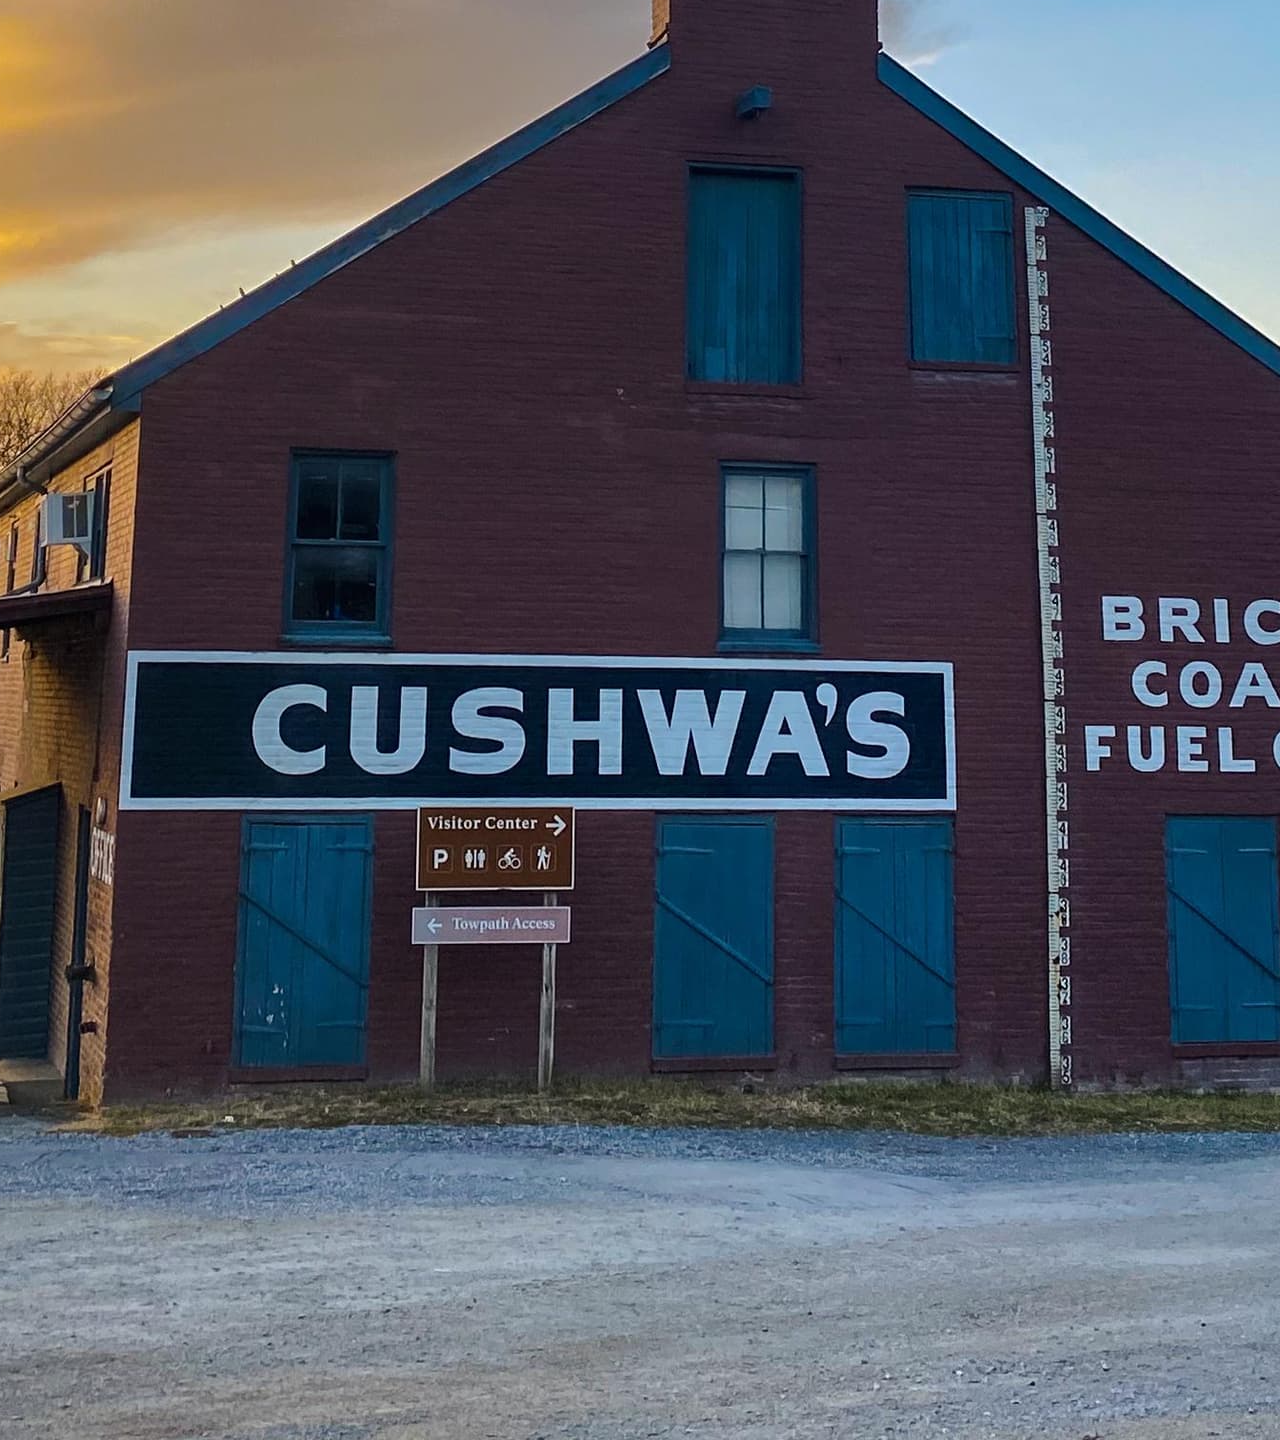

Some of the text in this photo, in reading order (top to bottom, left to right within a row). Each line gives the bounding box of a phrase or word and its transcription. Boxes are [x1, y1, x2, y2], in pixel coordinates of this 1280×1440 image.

[1040, 305, 1048, 330] 55
[1042, 340, 1050, 365] 54
[1043, 376, 1051, 401] 53
[1044, 412, 1052, 437] 52
[1046, 447, 1054, 472] 51
[1047, 484, 1055, 509] 50
[1051, 594, 1060, 620] 47
[1054, 669, 1063, 695] 45
[251, 682, 911, 780] CUSHWA'S
[1055, 708, 1064, 733] 44
[1056, 745, 1065, 771] 43
[1084, 725, 1256, 773] FUEL
[1057, 783, 1066, 810] 42
[427, 816, 538, 830] Visitor Center
[1058, 822, 1066, 849] 41
[433, 849, 448, 870] P
[452, 917, 555, 933] Towpath Access
[1060, 938, 1069, 965] 38
[1061, 977, 1069, 1004] 37
[1061, 1016, 1069, 1043] 36
[1061, 1056, 1070, 1083] 35
